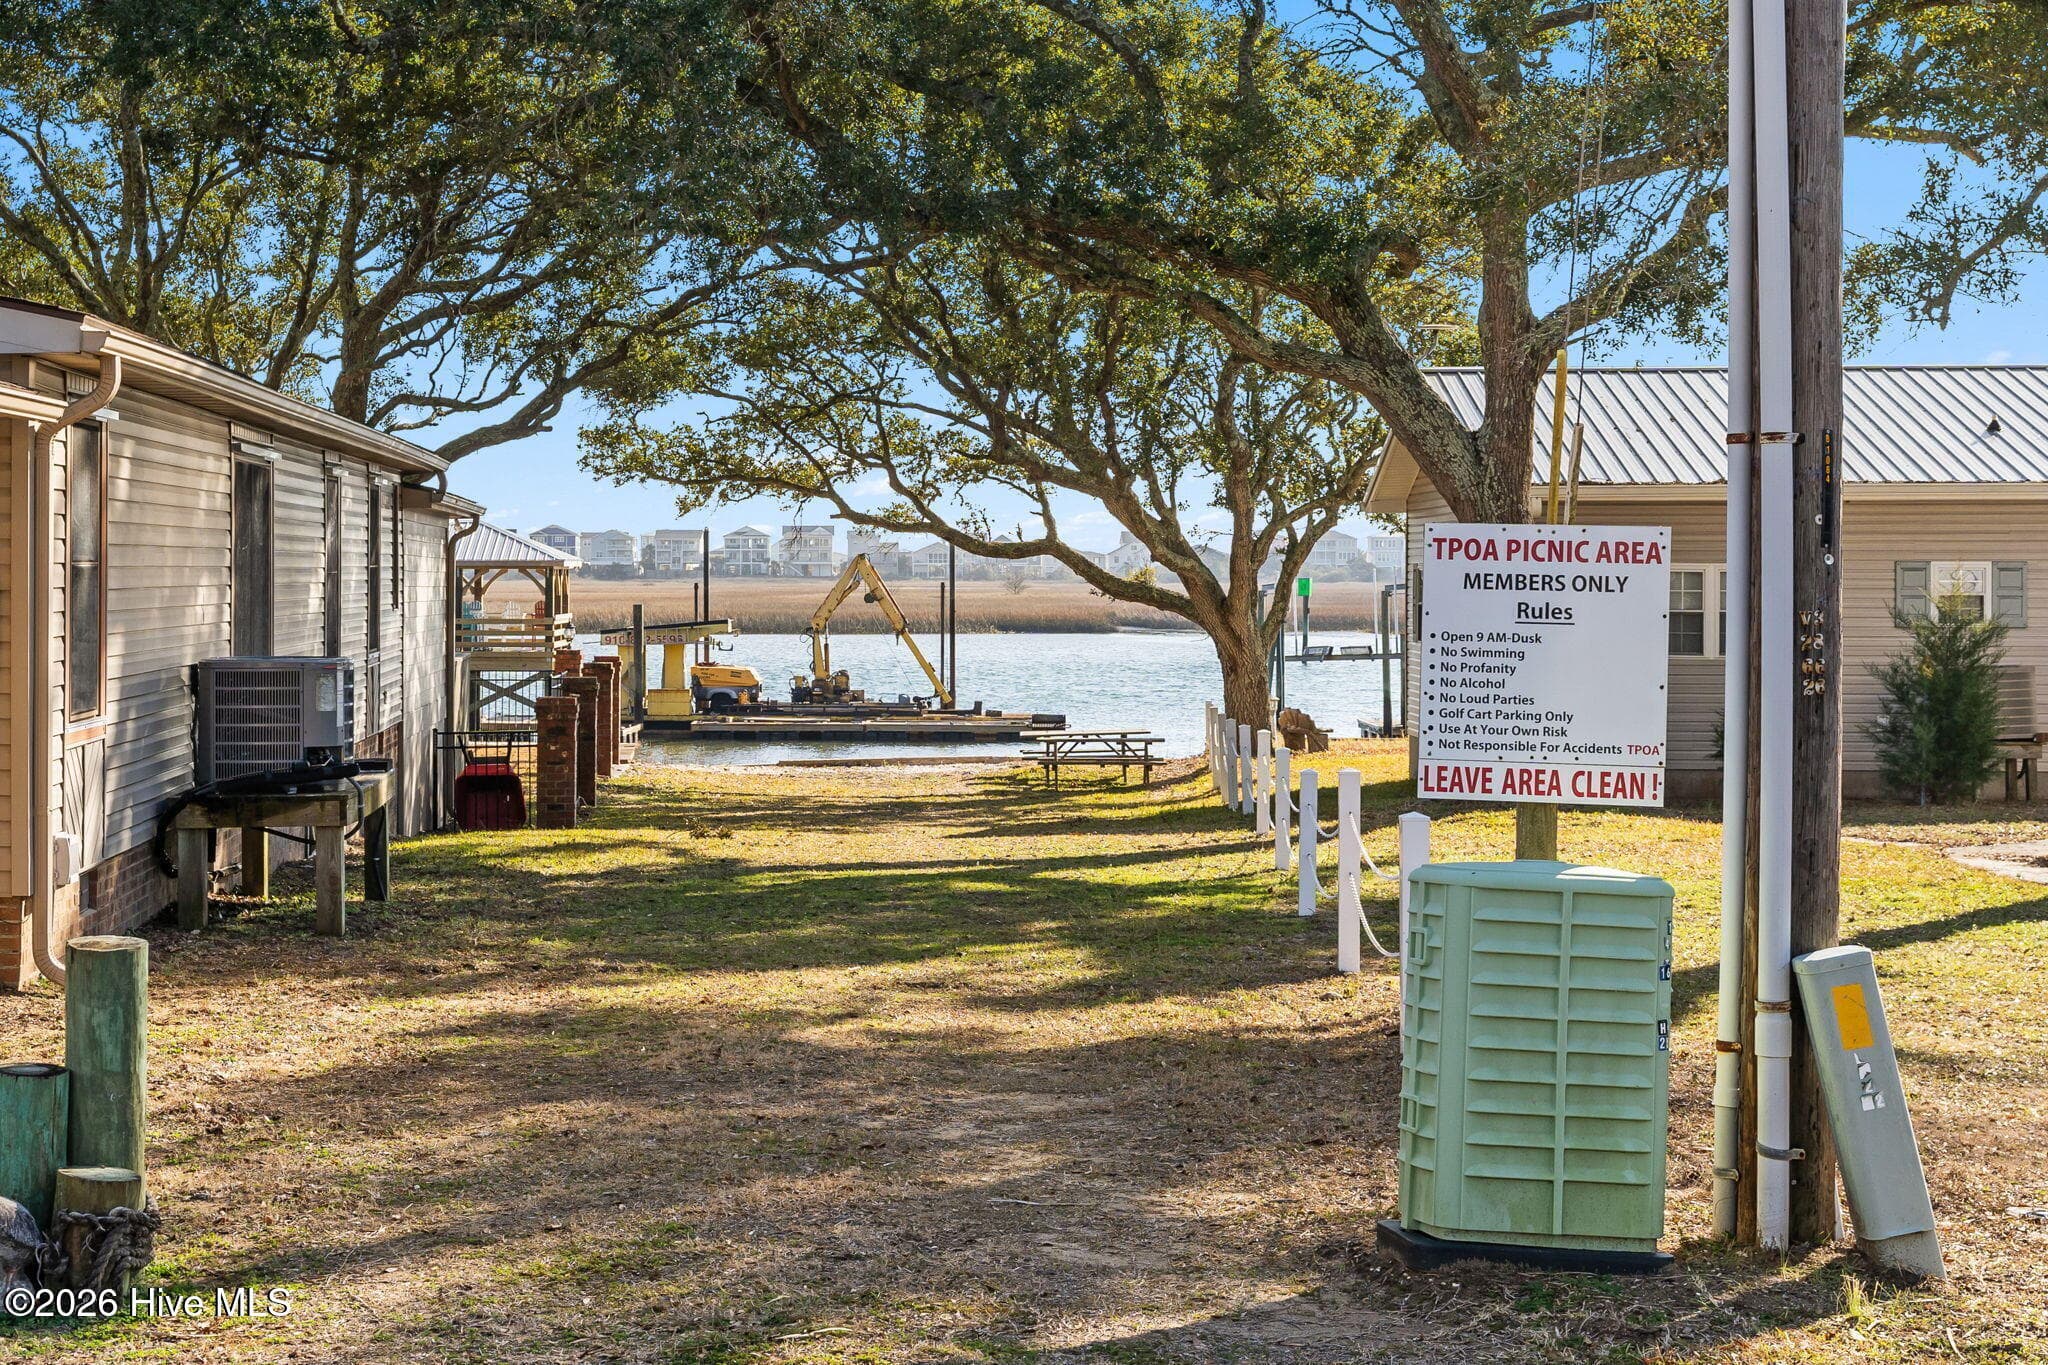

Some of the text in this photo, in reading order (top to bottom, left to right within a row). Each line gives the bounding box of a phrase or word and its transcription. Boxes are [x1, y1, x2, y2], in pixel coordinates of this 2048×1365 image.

[1431, 537, 1663, 565] TPOA PICNIC AREA
[1463, 572, 1629, 594] MEMBERS ONLY
[1516, 601, 1573, 621] Rules
[1440, 630, 1543, 645] Open 9 AM-Dusk
[1440, 646, 1525, 662] No Swimming
[1440, 661, 1517, 677] No Profanity
[1439, 676, 1506, 690] No Alcohol
[1439, 692, 1535, 706] No Loud Parties
[1438, 707, 1574, 725] Golf Cart Parking Only
[1439, 722, 1568, 738] Use At Your Own Risk
[1438, 738, 1660, 756] Not Responsible For Accidents TPOA
[1423, 764, 1493, 795] LEAVE
[1501, 767, 1563, 797] AREA
